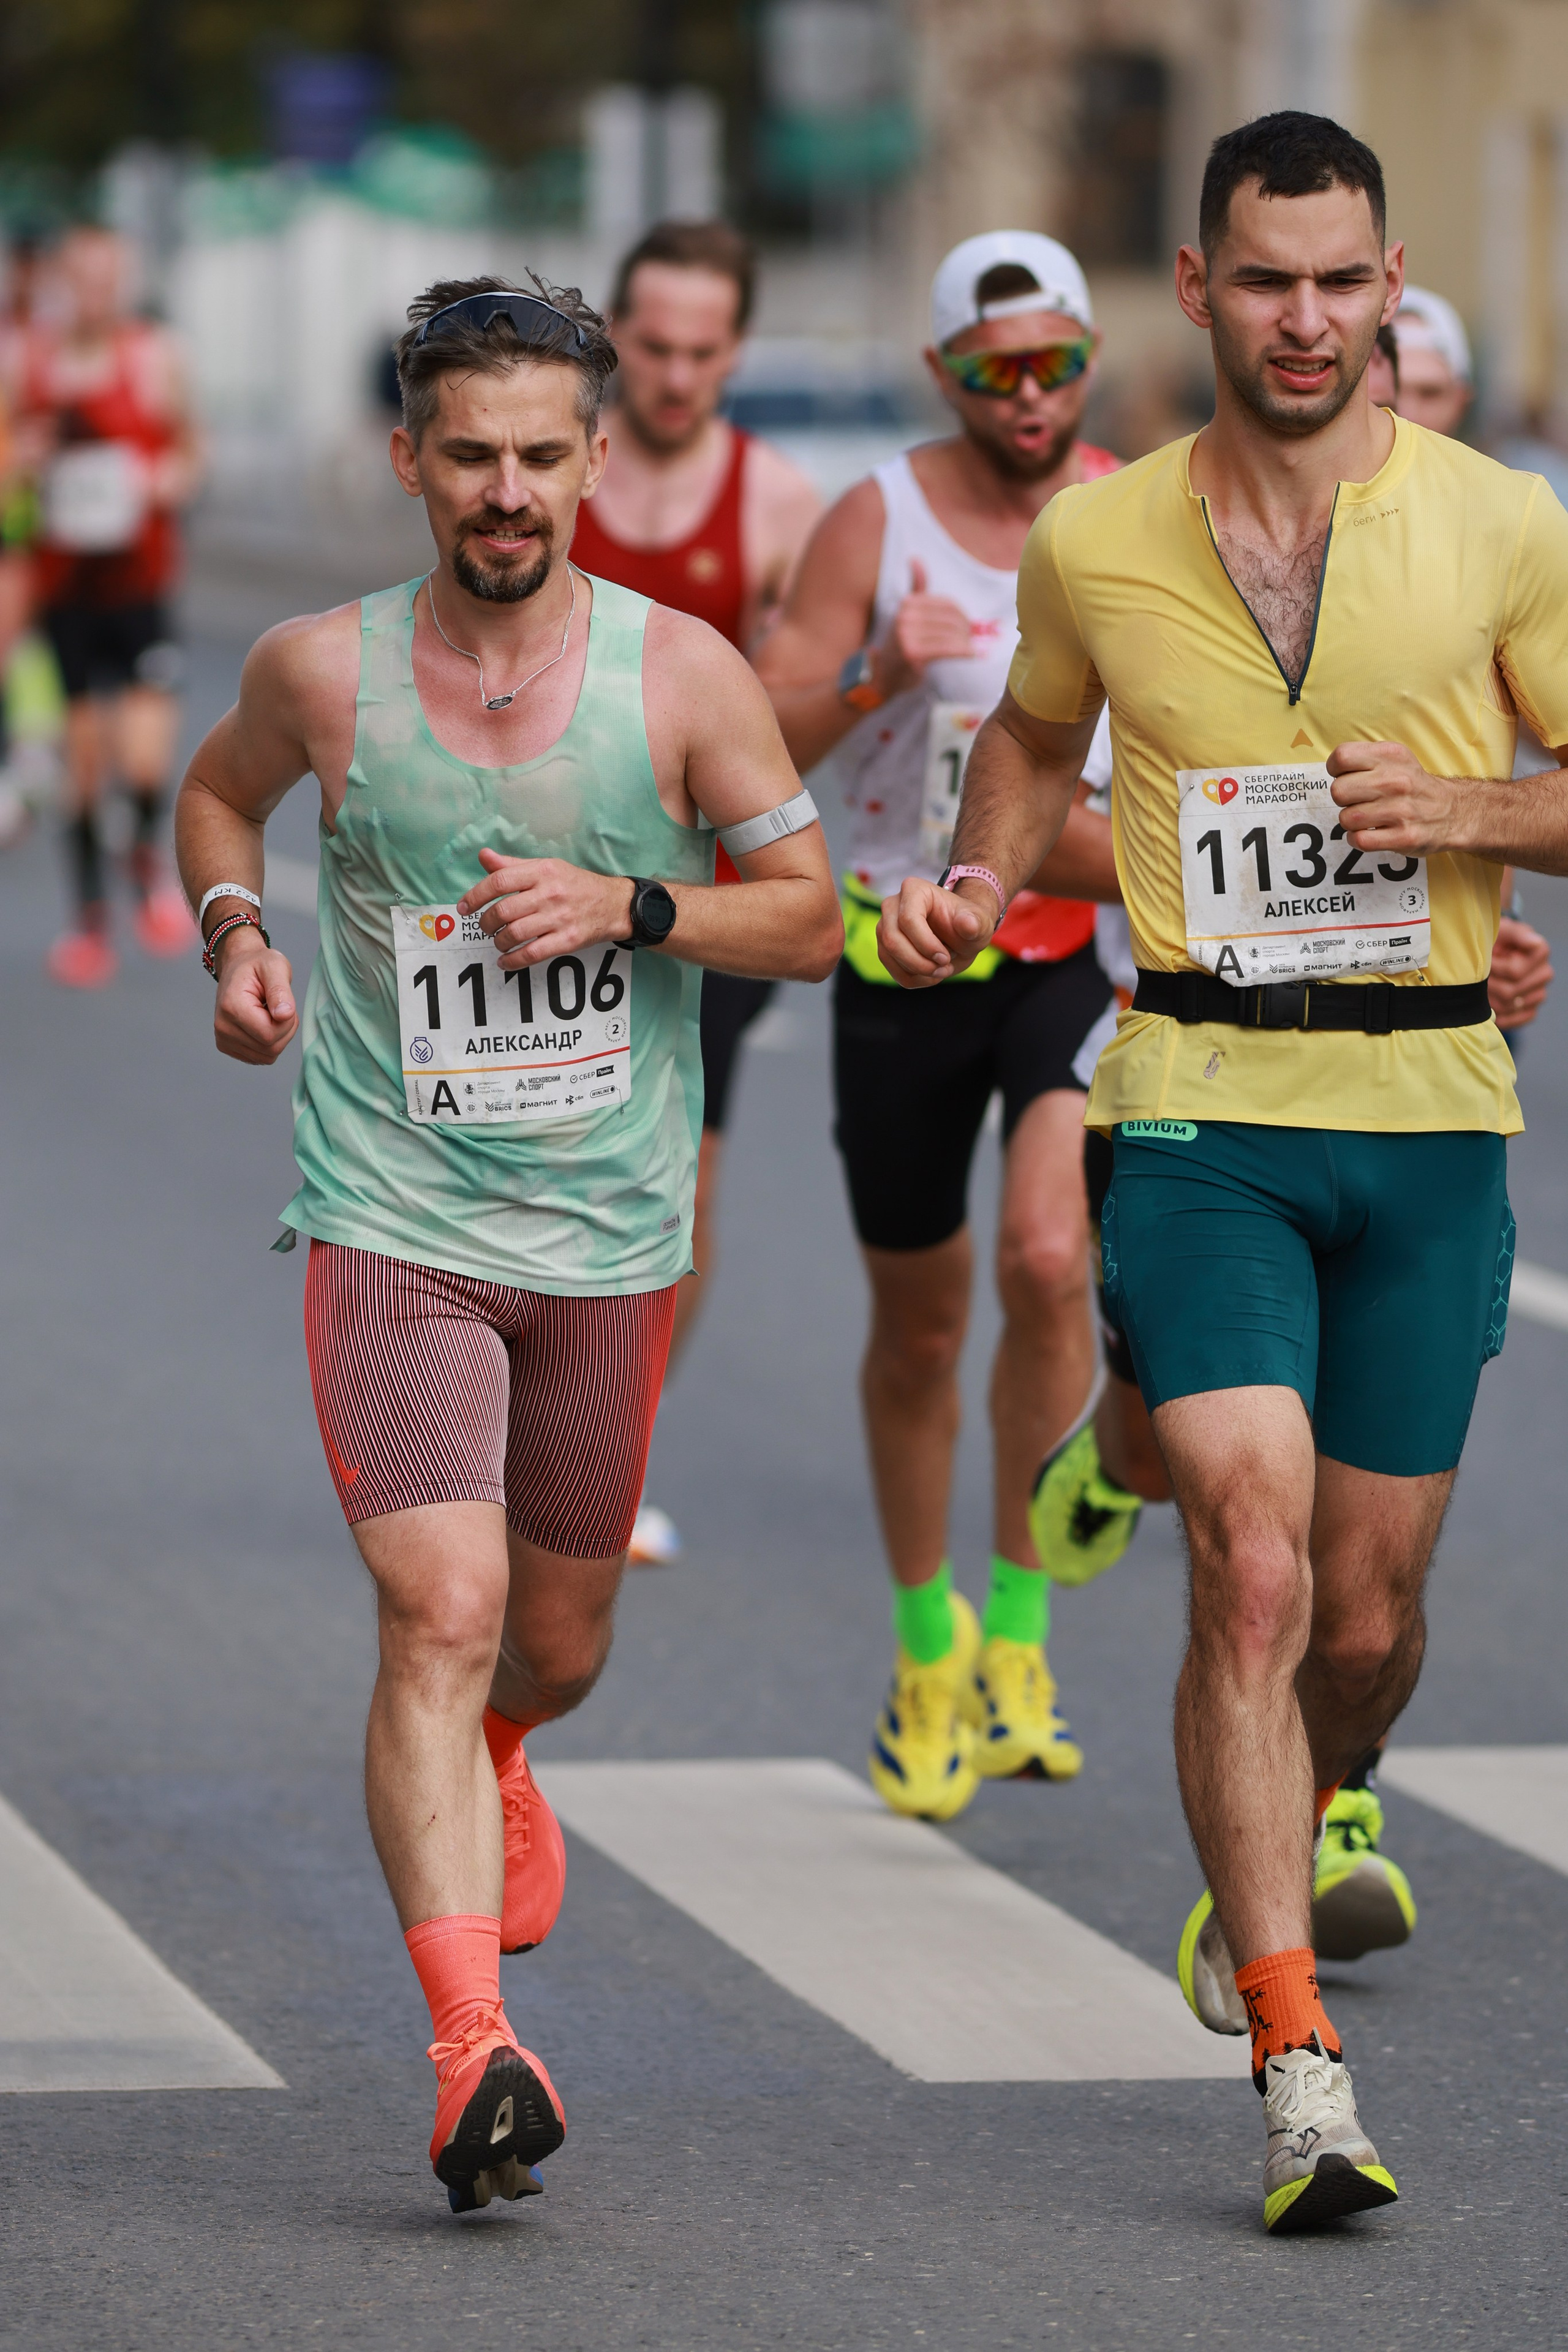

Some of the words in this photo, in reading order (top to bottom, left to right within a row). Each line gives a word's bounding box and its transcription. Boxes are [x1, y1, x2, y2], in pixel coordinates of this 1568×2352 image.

[1353, 514, 1376, 527] беги
[1245, 772, 1305, 783] СБЕРПРАЙМ
[1245, 778, 1327, 794] МОСКОВСКИЙ
[1246, 792, 1306, 805] МАРАФОН
[236, 889, 256, 902] 42.2
[1408, 895, 1416, 906] 3
[1264, 891, 1355, 918] АЛЕКСЕЙ
[1313, 937, 1346, 948] МОСКОВСКИЙ
[1382, 957, 1404, 965] WINLINE
[413, 948, 624, 1029] 11106
[612, 1024, 619, 1035] 2
[466, 1030, 582, 1055] АЛЕКСАНДР
[528, 1074, 561, 1084] МОСКОВСКИЙ
[579, 1071, 595, 1080] СБЕР
[592, 1088, 610, 1096] WINLINE
[527, 1099, 557, 1108] магнит
[1128, 1121, 1187, 1136] BIVIUM
